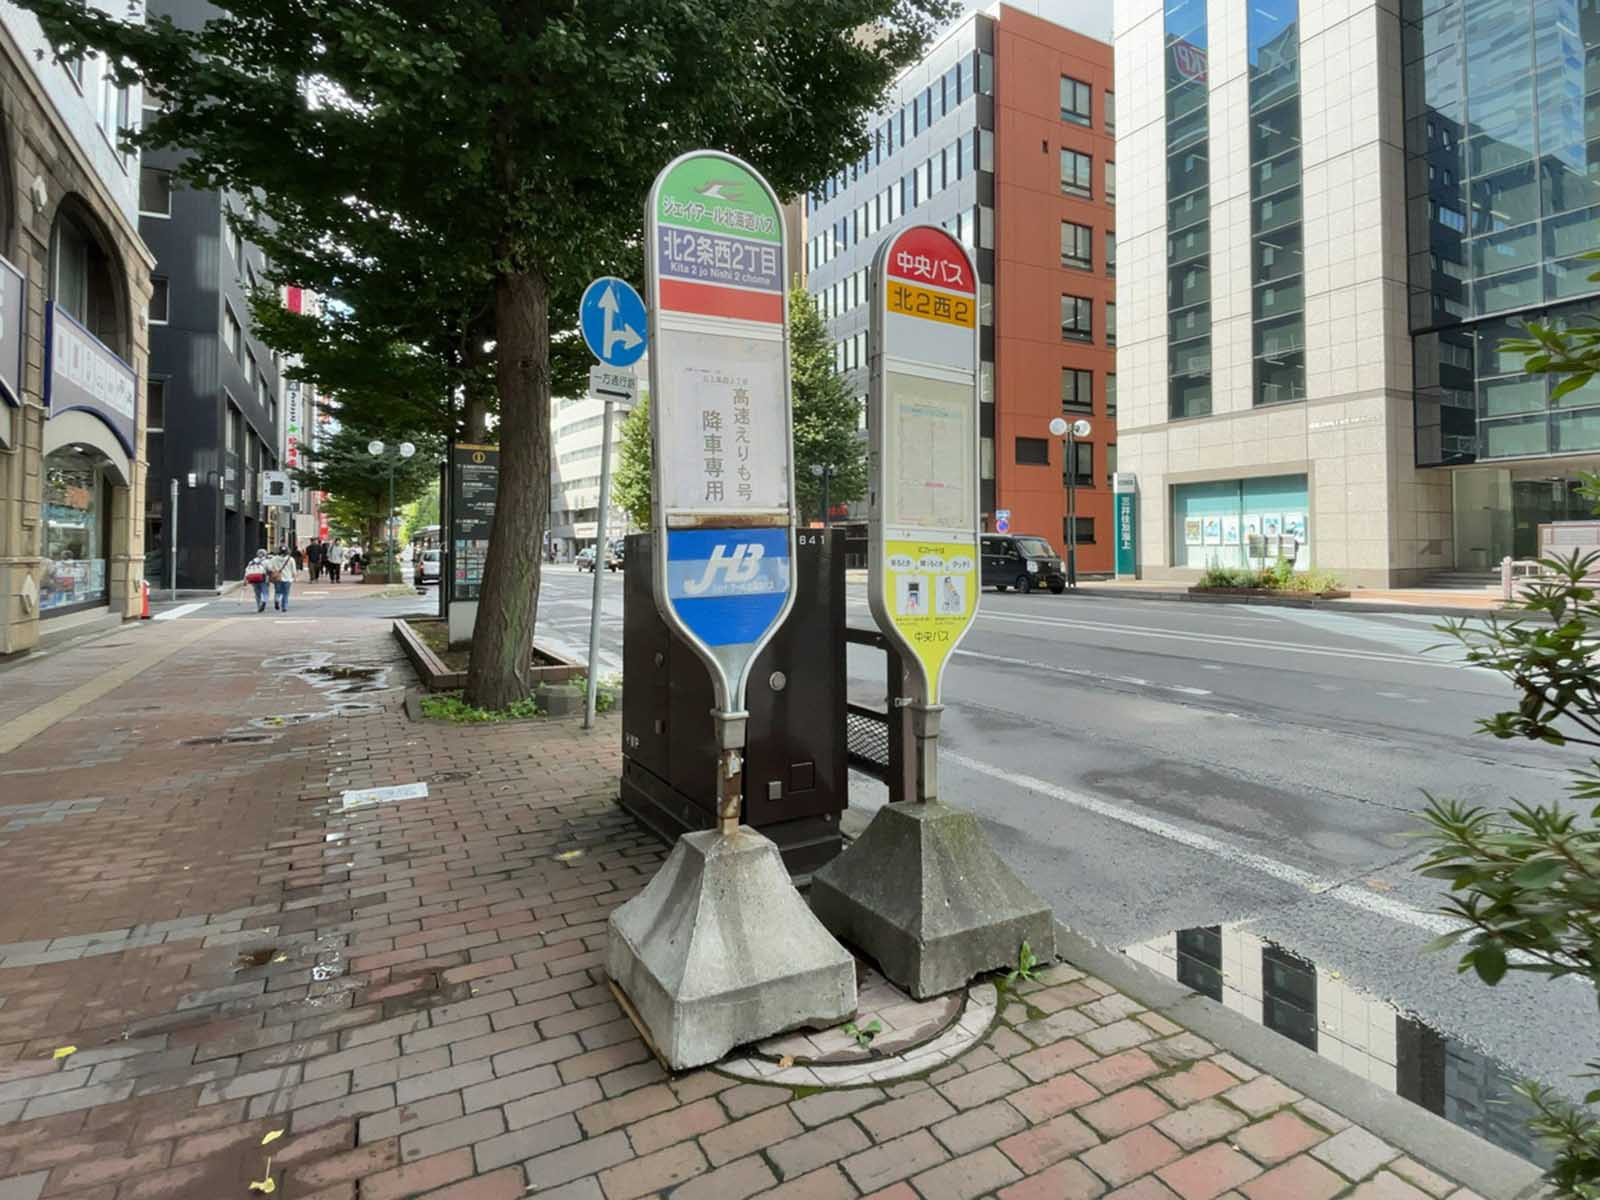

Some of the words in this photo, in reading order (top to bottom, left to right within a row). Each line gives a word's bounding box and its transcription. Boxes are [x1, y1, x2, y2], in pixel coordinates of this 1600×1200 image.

[663, 196, 776, 233] ジェイアール北海道バス
[664, 230, 777, 277] 北2条西2丁目
[671, 262, 689, 273] Kita
[691, 265, 697, 275] 2
[699, 266, 708, 277] jo
[710, 268, 733, 280] Nishi
[734, 271, 740, 281] 2
[896, 251, 963, 286] 中央バス
[894, 287, 968, 322] 北2西2
[702, 409, 725, 501] 降車専用
[733, 387, 753, 501] 高速えりも号
[914, 631, 949, 643] 中央バス
